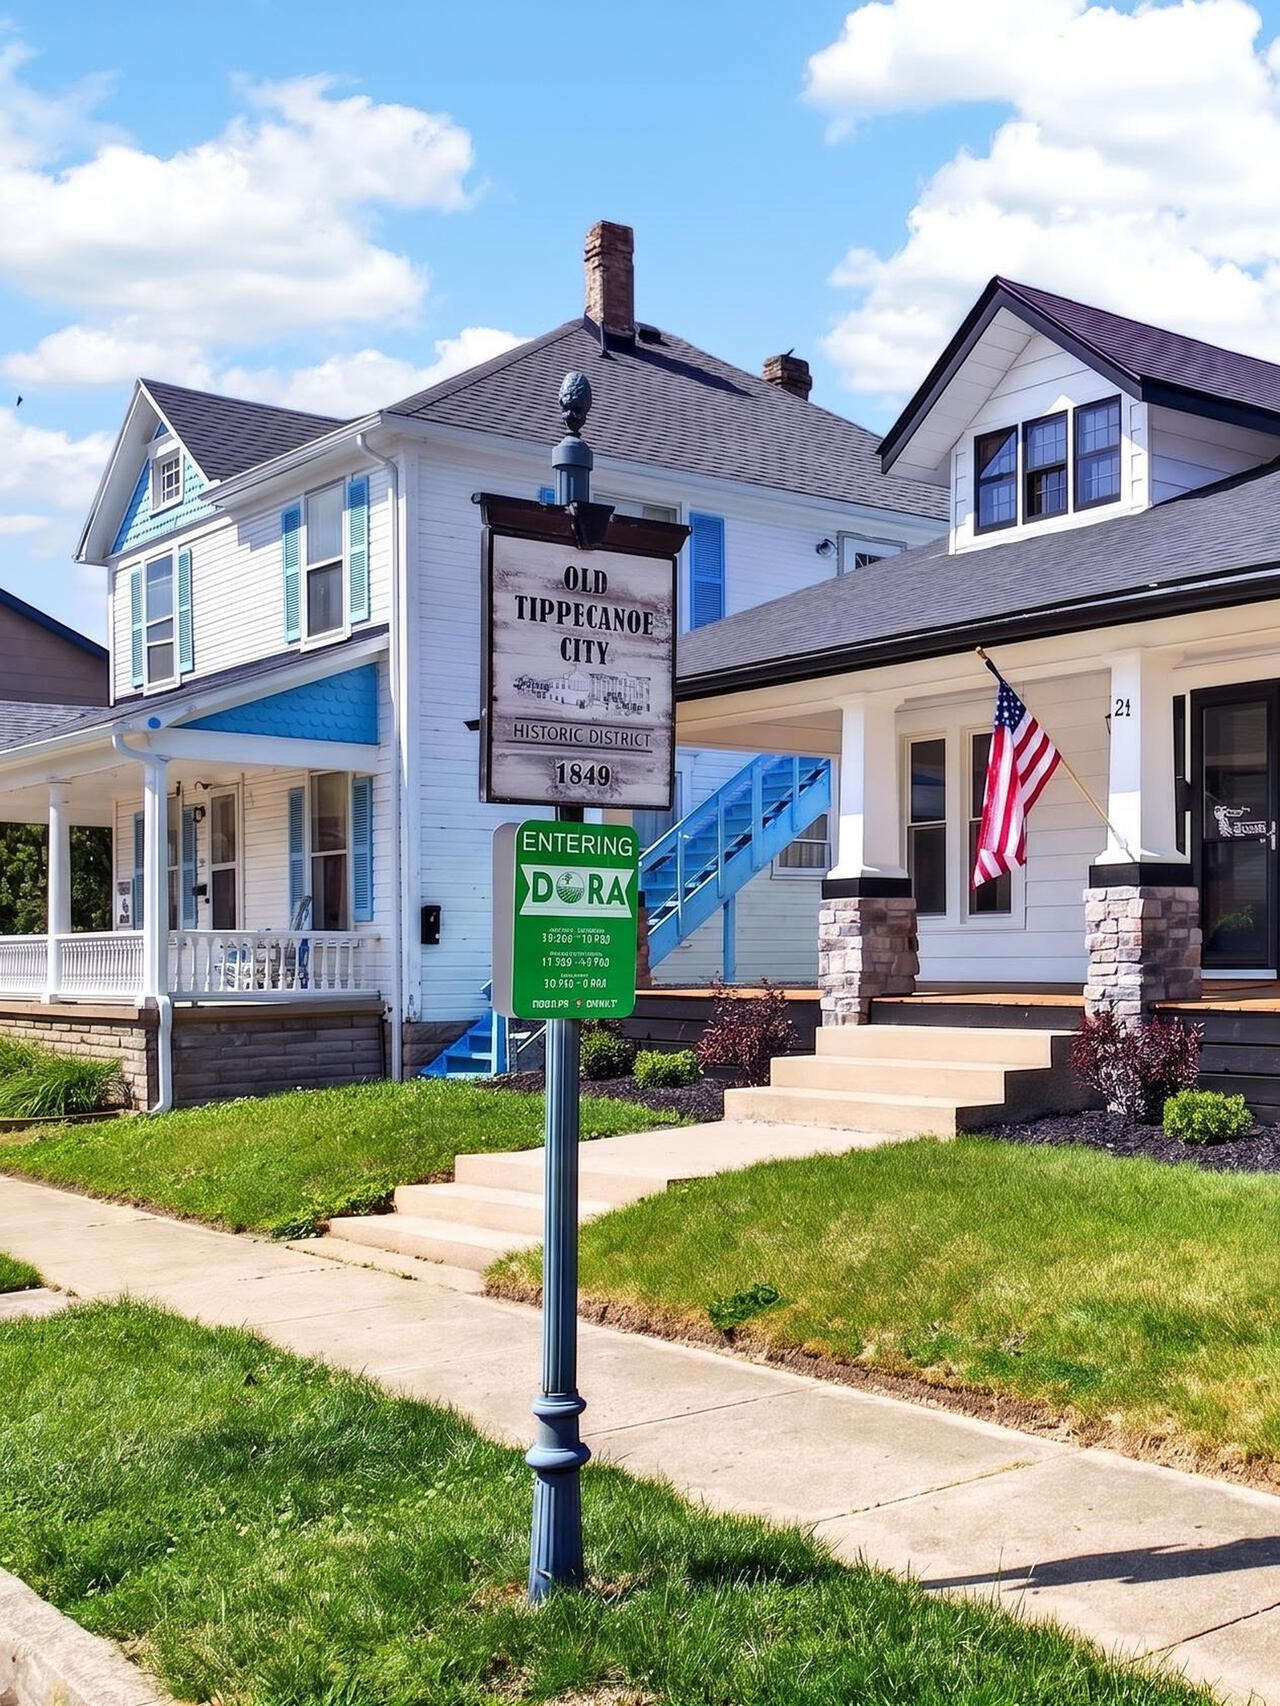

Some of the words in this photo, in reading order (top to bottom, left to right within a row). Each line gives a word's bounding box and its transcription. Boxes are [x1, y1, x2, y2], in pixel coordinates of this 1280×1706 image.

[563, 565, 607, 595] OLD
[514, 594, 654, 636] TIPPECANOE
[560, 636, 610, 666] CITY
[513, 723, 584, 743] HISTORIC
[589, 728, 651, 747] DISTRICT
[556, 762, 611, 786] 1849
[523, 831, 633, 857] ENTERING
